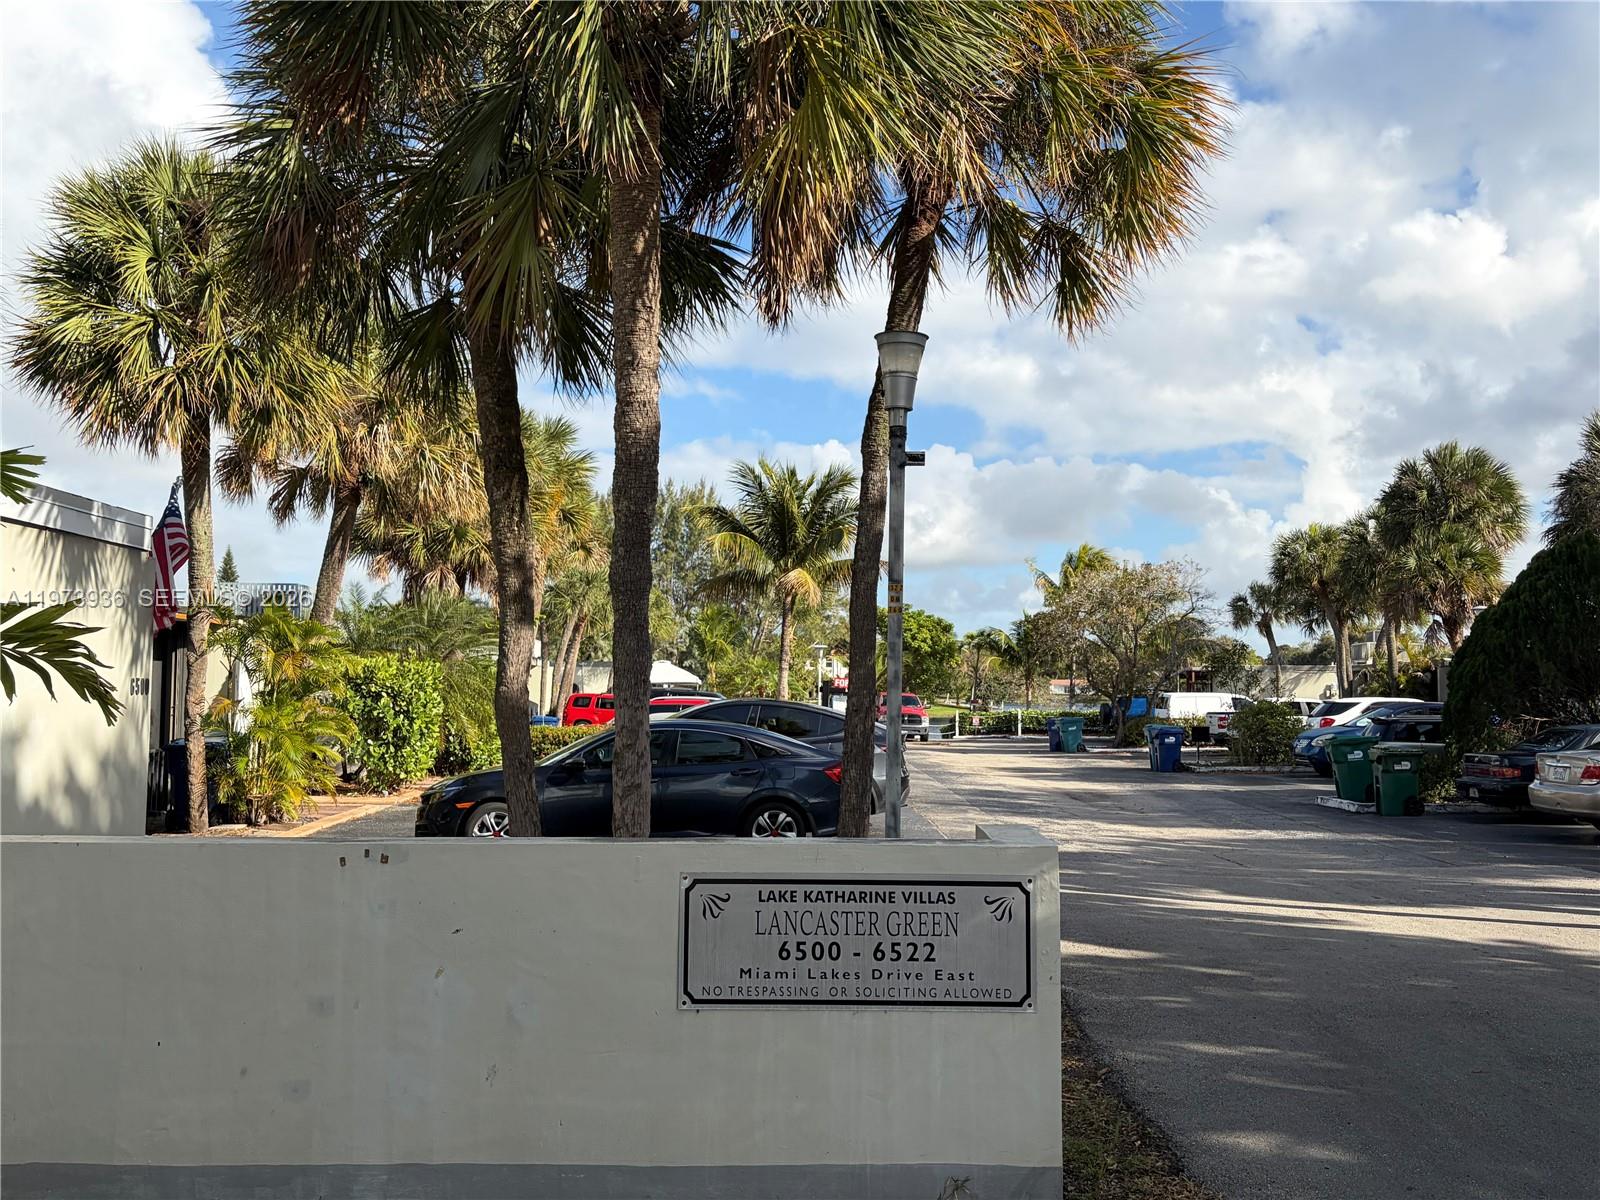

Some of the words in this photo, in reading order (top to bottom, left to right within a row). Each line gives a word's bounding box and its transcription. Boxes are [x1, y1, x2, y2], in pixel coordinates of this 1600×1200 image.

[758, 889, 798, 904] LAKE
[803, 889, 896, 905] KATHARINE
[901, 890, 956, 905] VILLAS
[754, 910, 882, 937] LANCASTER
[886, 911, 960, 938] GREEN
[777, 941, 842, 962] 6500
[872, 942, 937, 963] 6522
[739, 967, 797, 980] Miami
[807, 967, 861, 981] Lakes
[871, 968, 924, 981] Drive
[934, 969, 975, 982] East
[701, 985, 723, 998] NO
[728, 985, 819, 998] TRESPASSING
[829, 986, 848, 998] OR
[855, 986, 937, 999] SOLICITING
[944, 987, 1013, 1000] ALLOWED
